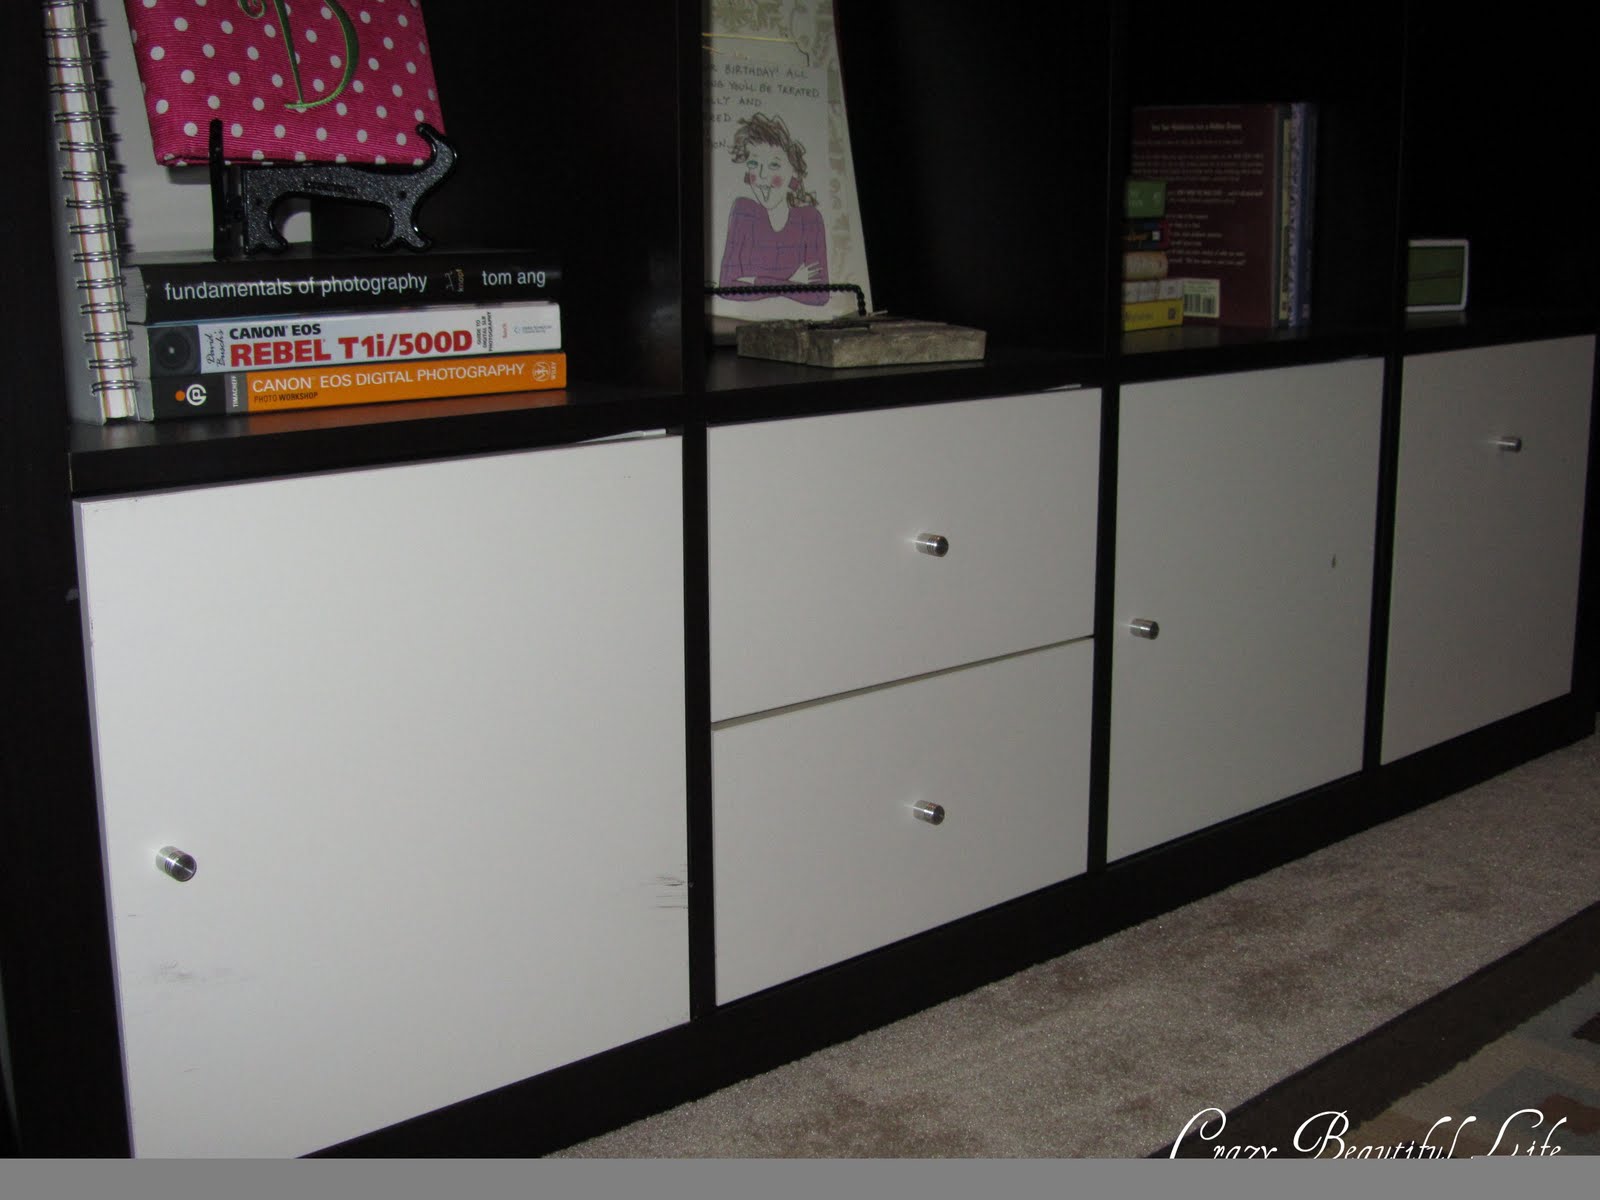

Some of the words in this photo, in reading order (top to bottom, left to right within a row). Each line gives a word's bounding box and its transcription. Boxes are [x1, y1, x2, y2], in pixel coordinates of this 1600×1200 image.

[778, 84, 820, 98] TREATED
[739, 97, 763, 107] AND
[165, 278, 292, 300] fundamentals
[298, 276, 315, 294] of
[321, 273, 427, 297] photography
[482, 270, 512, 286] tom
[517, 270, 546, 287] ang
[229, 326, 287, 340] CANON
[292, 323, 322, 337] EOS
[230, 339, 332, 367] REBEL
[338, 329, 473, 360] T1i/500D
[252, 377, 312, 393] CANON
[320, 374, 352, 388] EOS
[356, 371, 414, 386] DIGITAL
[417, 363, 526, 381] PHOTOGRAPHY
[254, 393, 277, 403] PHOTO
[279, 391, 319, 401] WORKSHOP
